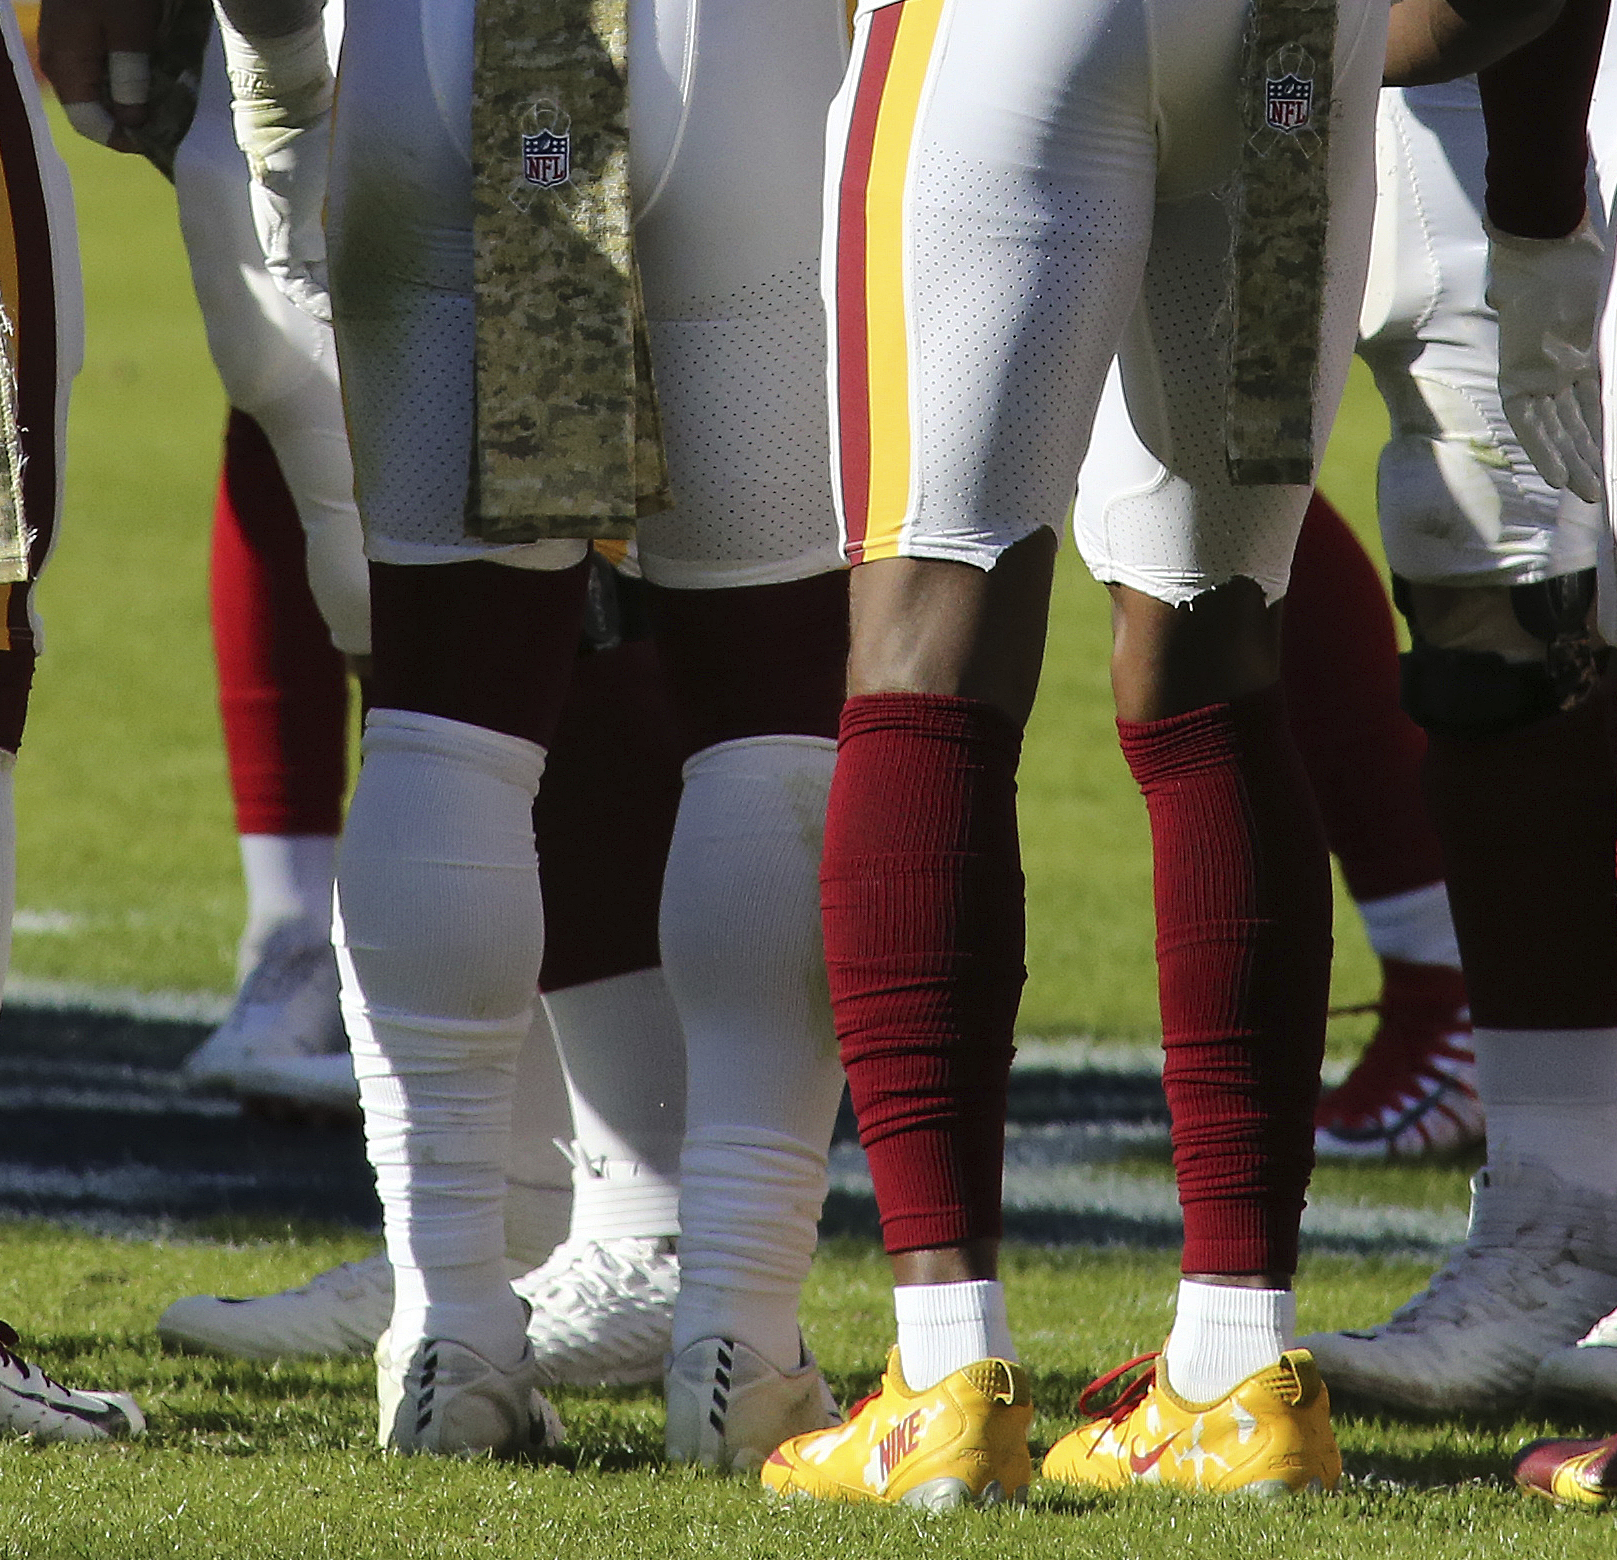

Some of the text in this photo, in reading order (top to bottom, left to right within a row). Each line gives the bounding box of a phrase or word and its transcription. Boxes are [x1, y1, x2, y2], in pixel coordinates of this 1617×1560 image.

[1268, 100, 1308, 127] NFL
[525, 156, 565, 183] NFL
[878, 1408, 923, 1483] NIKE
